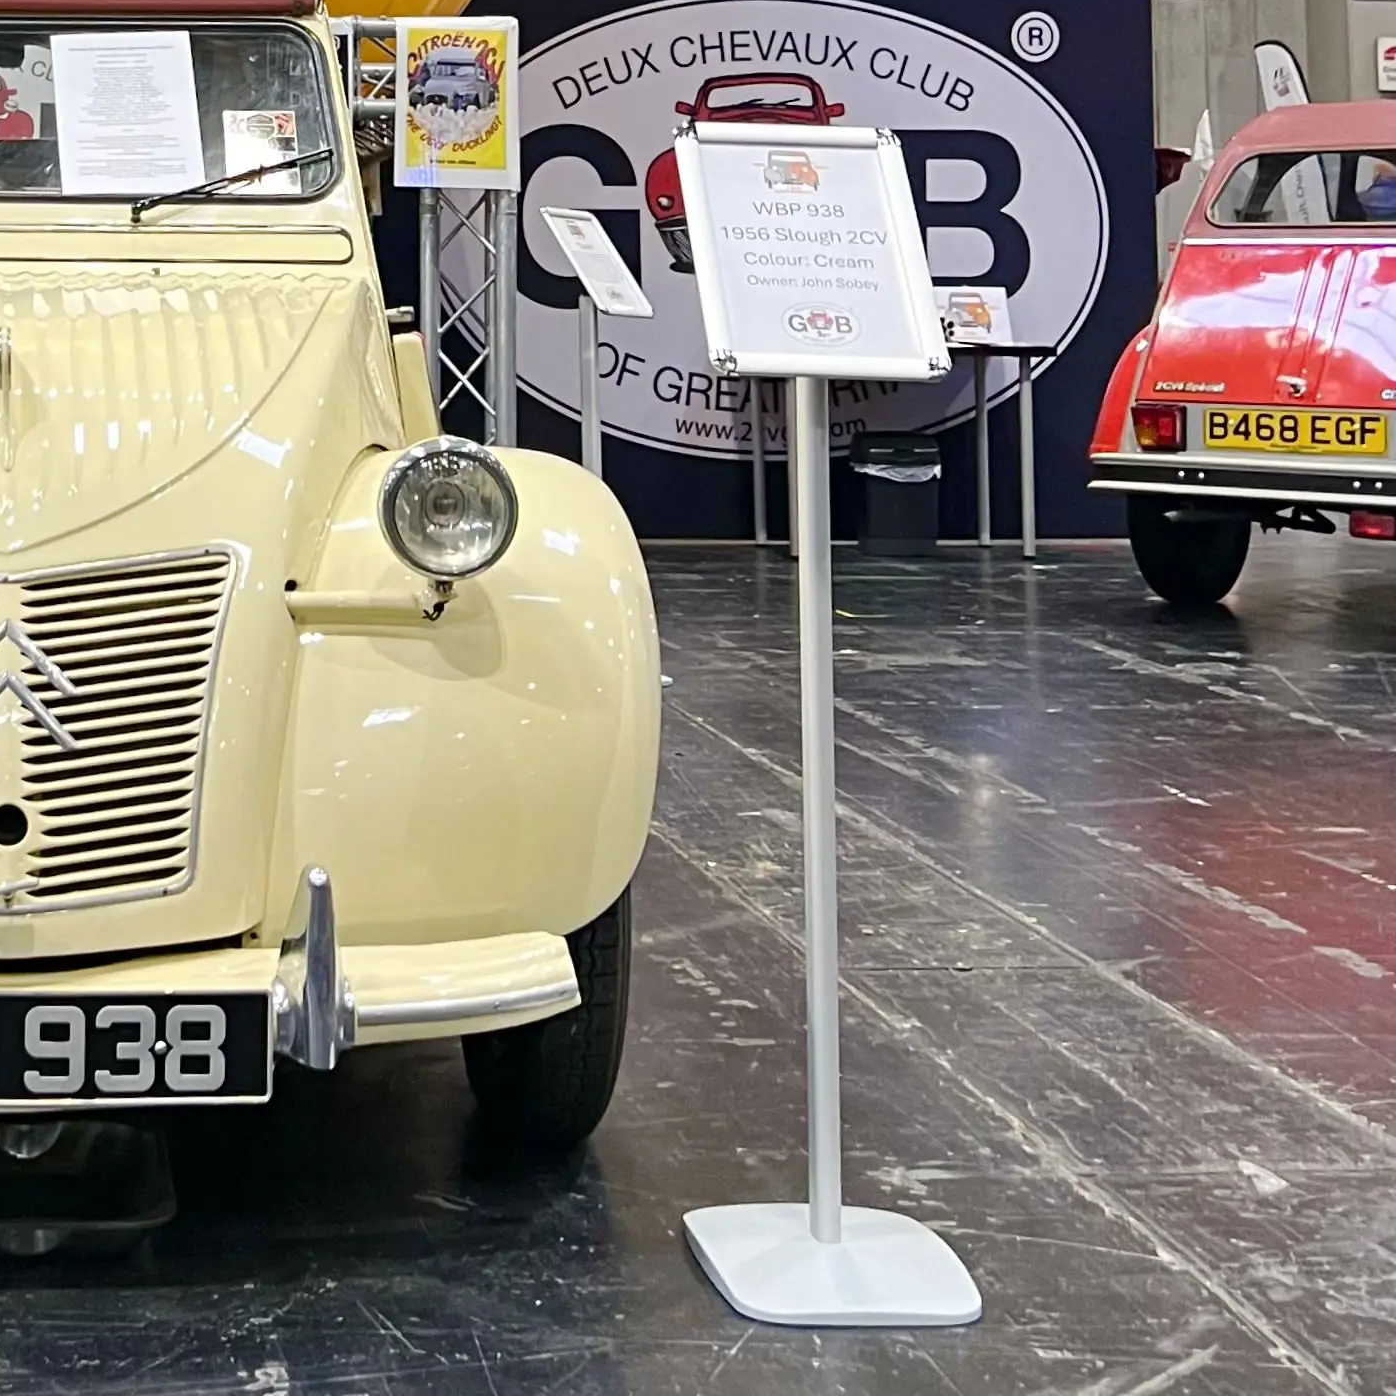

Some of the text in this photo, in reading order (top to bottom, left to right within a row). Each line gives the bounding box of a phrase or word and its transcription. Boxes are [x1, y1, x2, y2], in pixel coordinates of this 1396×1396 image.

[407, 31, 476, 78] CITROËN
[552, 30, 974, 111] DEUX CHEVAUX CLUB
[516, 123, 1031, 310] G B
[752, 201, 845, 218] WBP 938
[720, 226, 888, 246] 1956 Slough 2CV
[743, 251, 875, 269] Colour: Cream
[747, 274, 880, 292] Owner: John Sobey
[597, 342, 646, 385] OF
[1209, 412, 1381, 445] B468 EGF
[23, 1004, 226, 1094] 938
